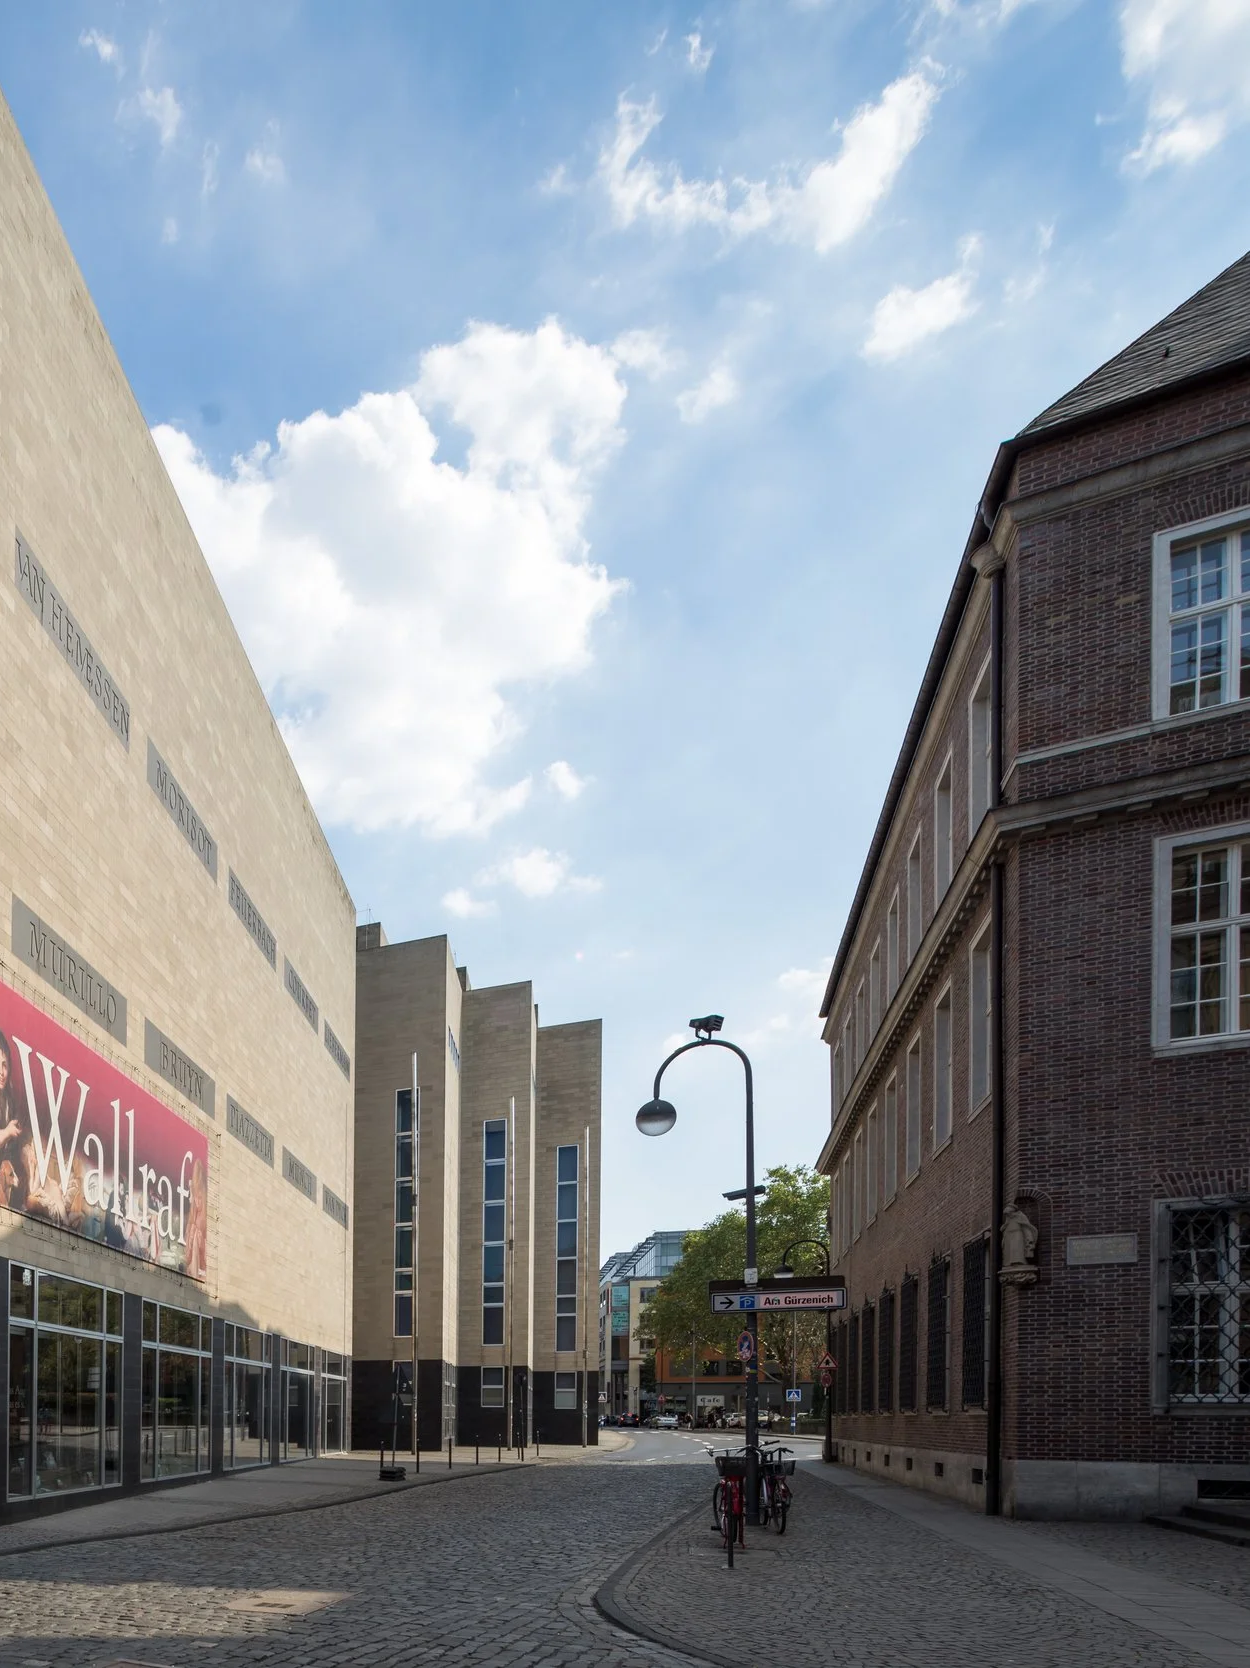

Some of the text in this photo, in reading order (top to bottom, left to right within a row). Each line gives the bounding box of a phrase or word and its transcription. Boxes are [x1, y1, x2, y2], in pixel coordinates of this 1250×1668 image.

[16, 538, 46, 619] VAN
[156, 759, 212, 865] MORISOT
[230, 876, 276, 965] FEUERBACH
[28, 920, 118, 1025] MURILLO
[159, 1041, 205, 1098] BRUYN
[12, 1035, 193, 1246] Wallraf
[230, 1104, 272, 1161] PIAZZETTA
[784, 1294, 834, 1306] Gürzenich
